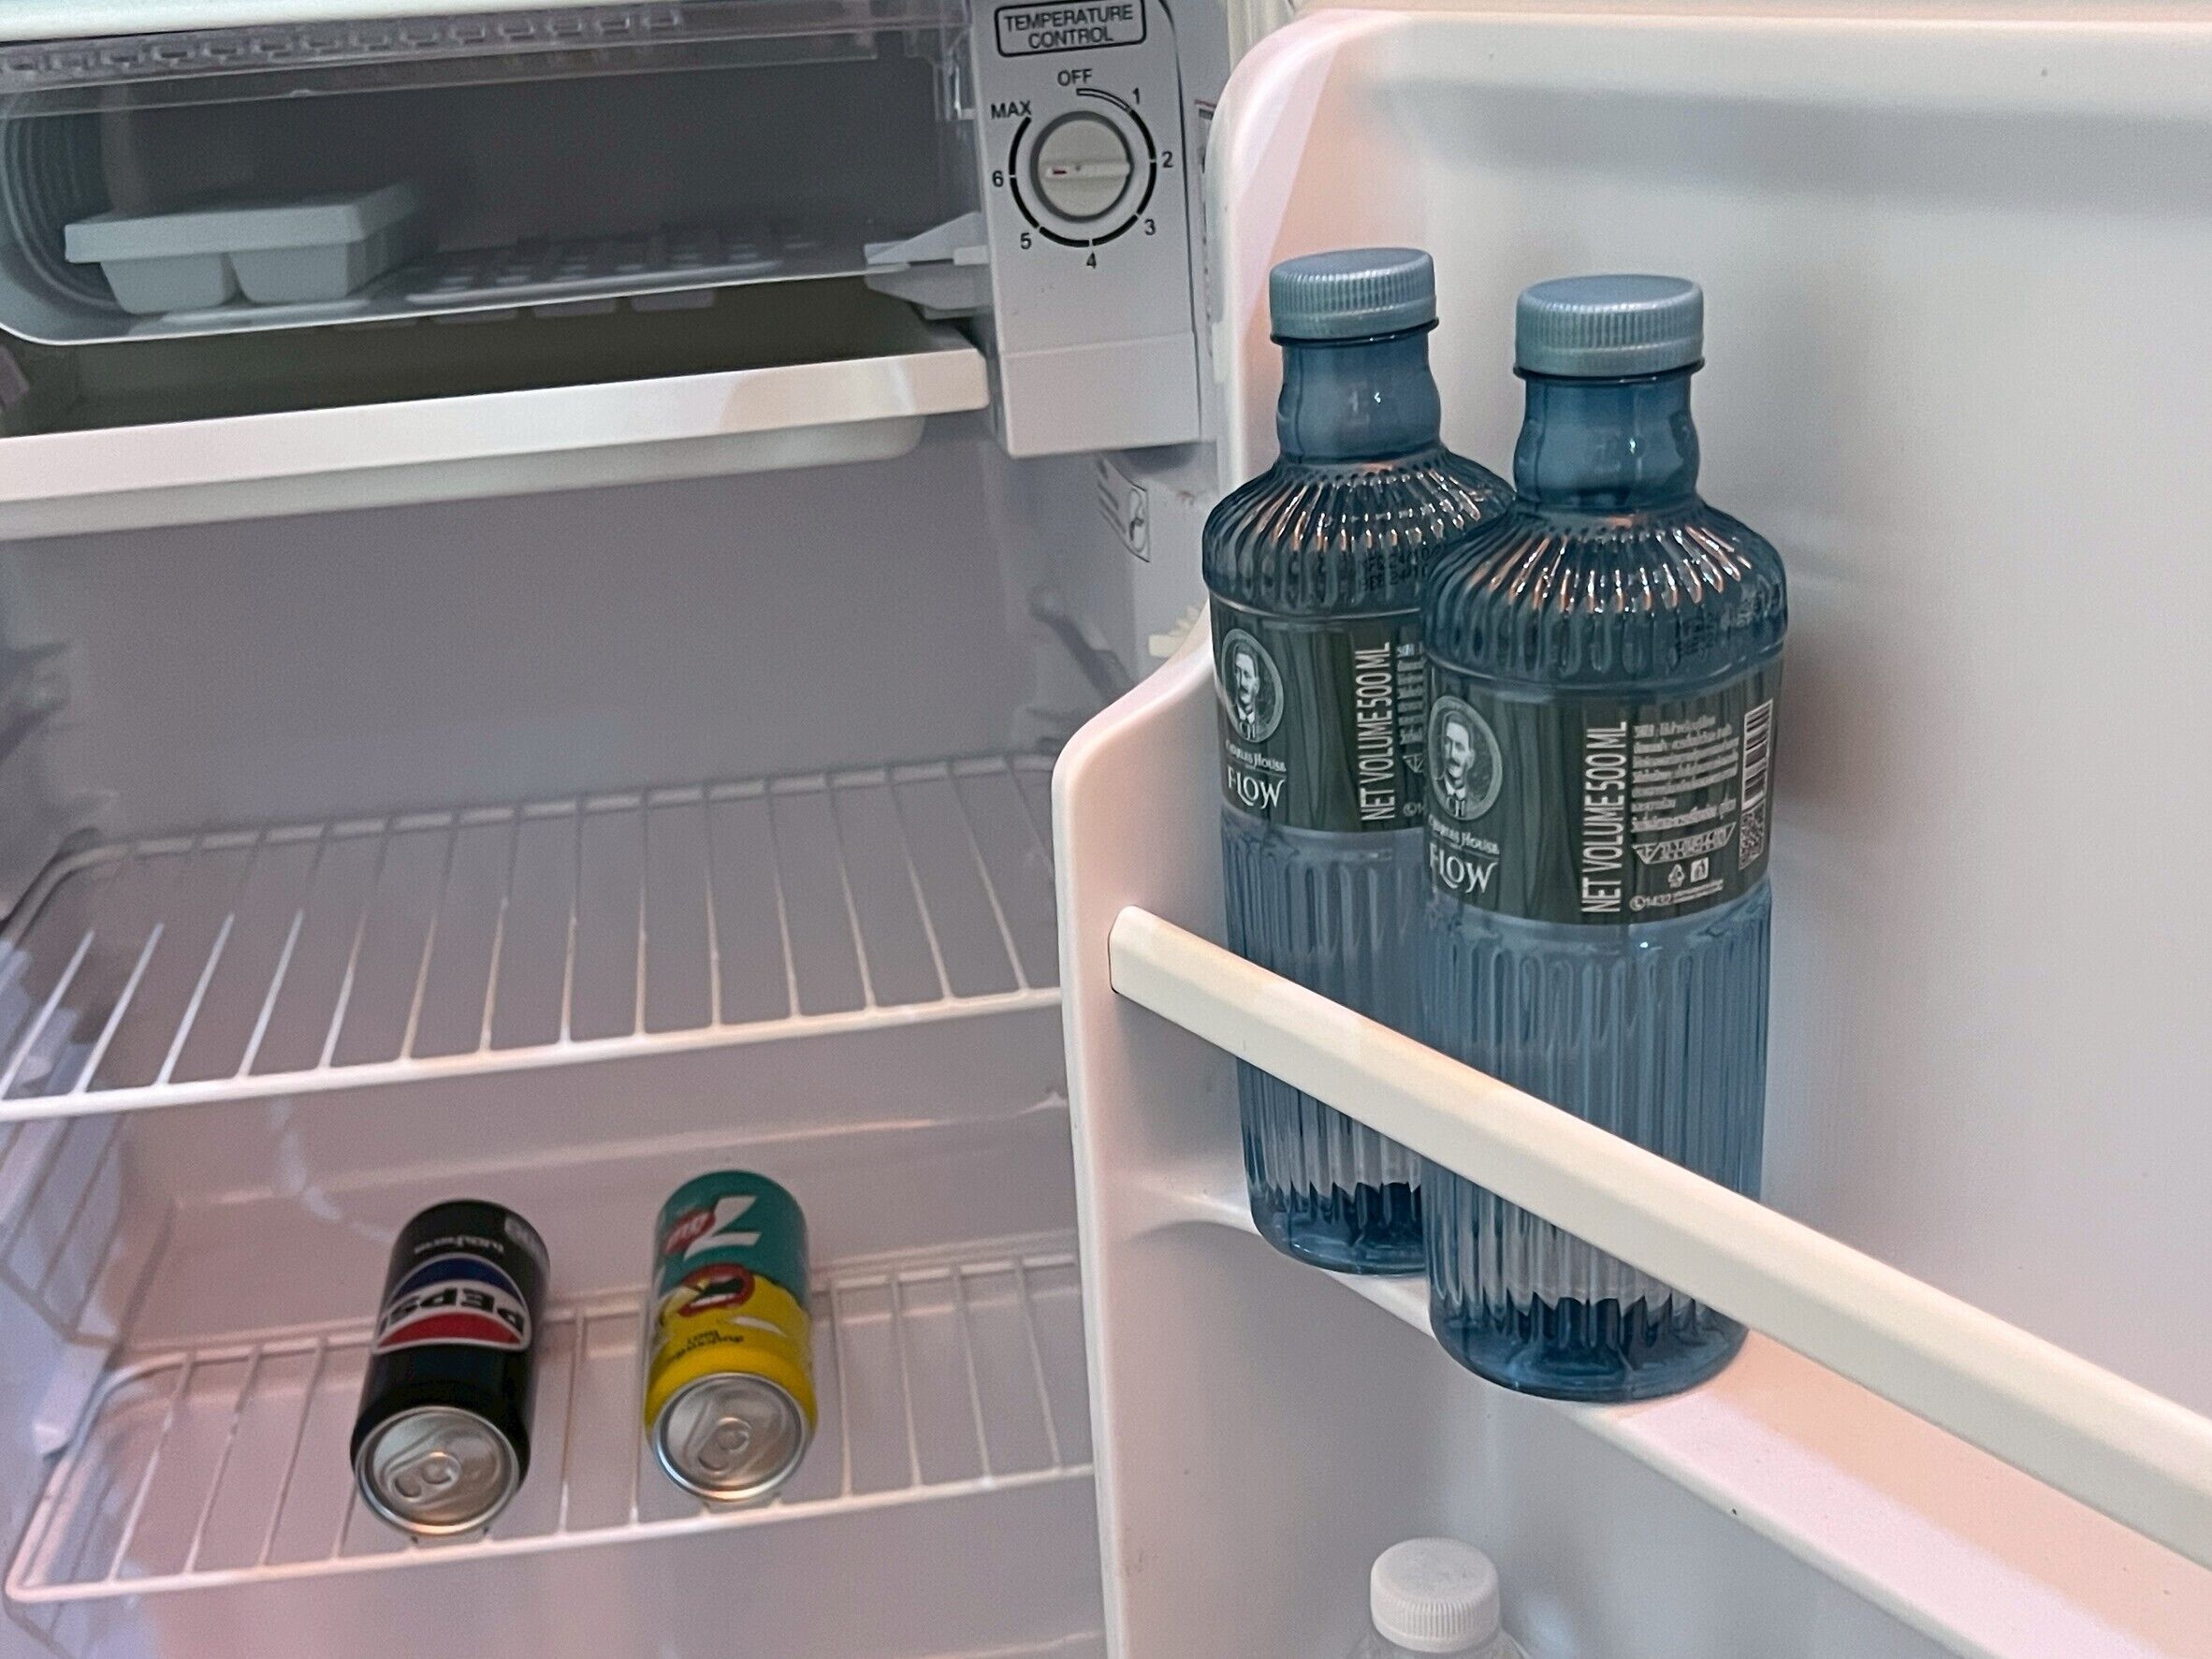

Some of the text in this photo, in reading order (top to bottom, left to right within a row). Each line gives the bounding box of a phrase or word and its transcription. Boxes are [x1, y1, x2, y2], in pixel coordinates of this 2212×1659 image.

[1004, 4, 1134, 33] TEMPERATURE
[1028, 25, 1114, 50] CONTROL
[1056, 68, 1093, 86] OFF
[1132, 88, 1141, 105] 1
[990, 100, 1032, 120] MAX
[1161, 152, 1174, 168] 2
[992, 170, 1005, 187] 6
[1144, 219, 1157, 236] 3
[1020, 232, 1032, 250] 5
[1085, 252, 1098, 269] 4
[1354, 641, 1396, 822] NET VOLUME 500 ML
[1227, 764, 1287, 810] FLOW
[1580, 720, 1628, 912] NET VOLUME 500 ML
[1429, 842, 1499, 894] FLOW
